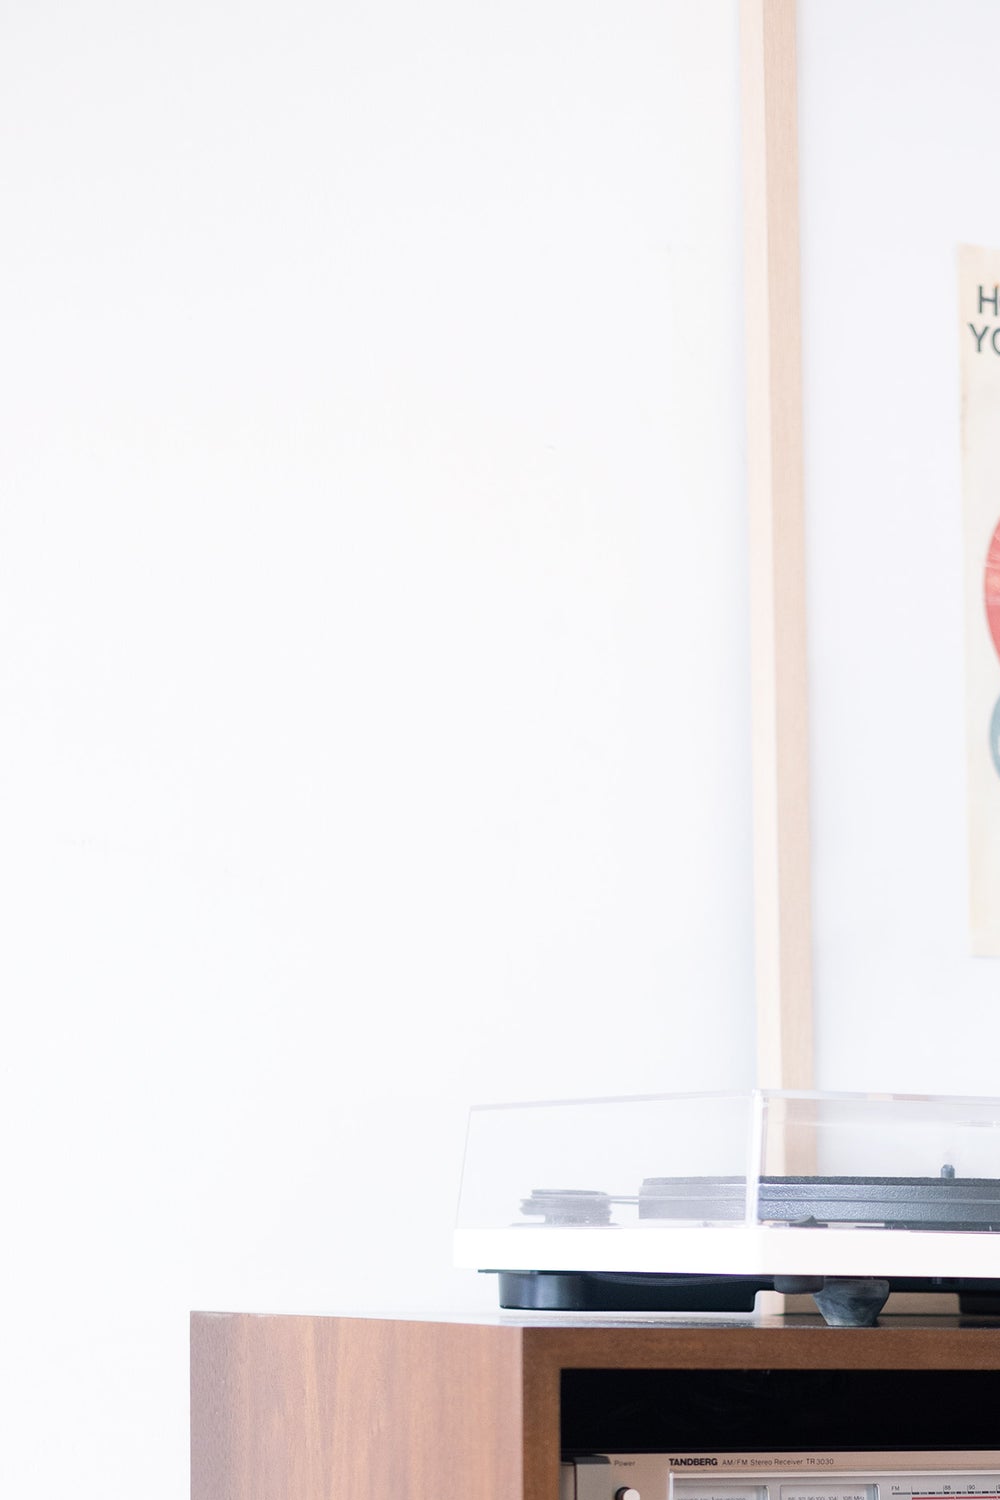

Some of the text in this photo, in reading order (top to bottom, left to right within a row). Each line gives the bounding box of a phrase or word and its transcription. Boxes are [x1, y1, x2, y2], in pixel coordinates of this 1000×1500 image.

[614, 1459, 636, 1468] Power
[669, 1458, 718, 1466] TANDBERG
[750, 1458, 773, 1466] Stereo
[774, 1458, 803, 1466] Receiver
